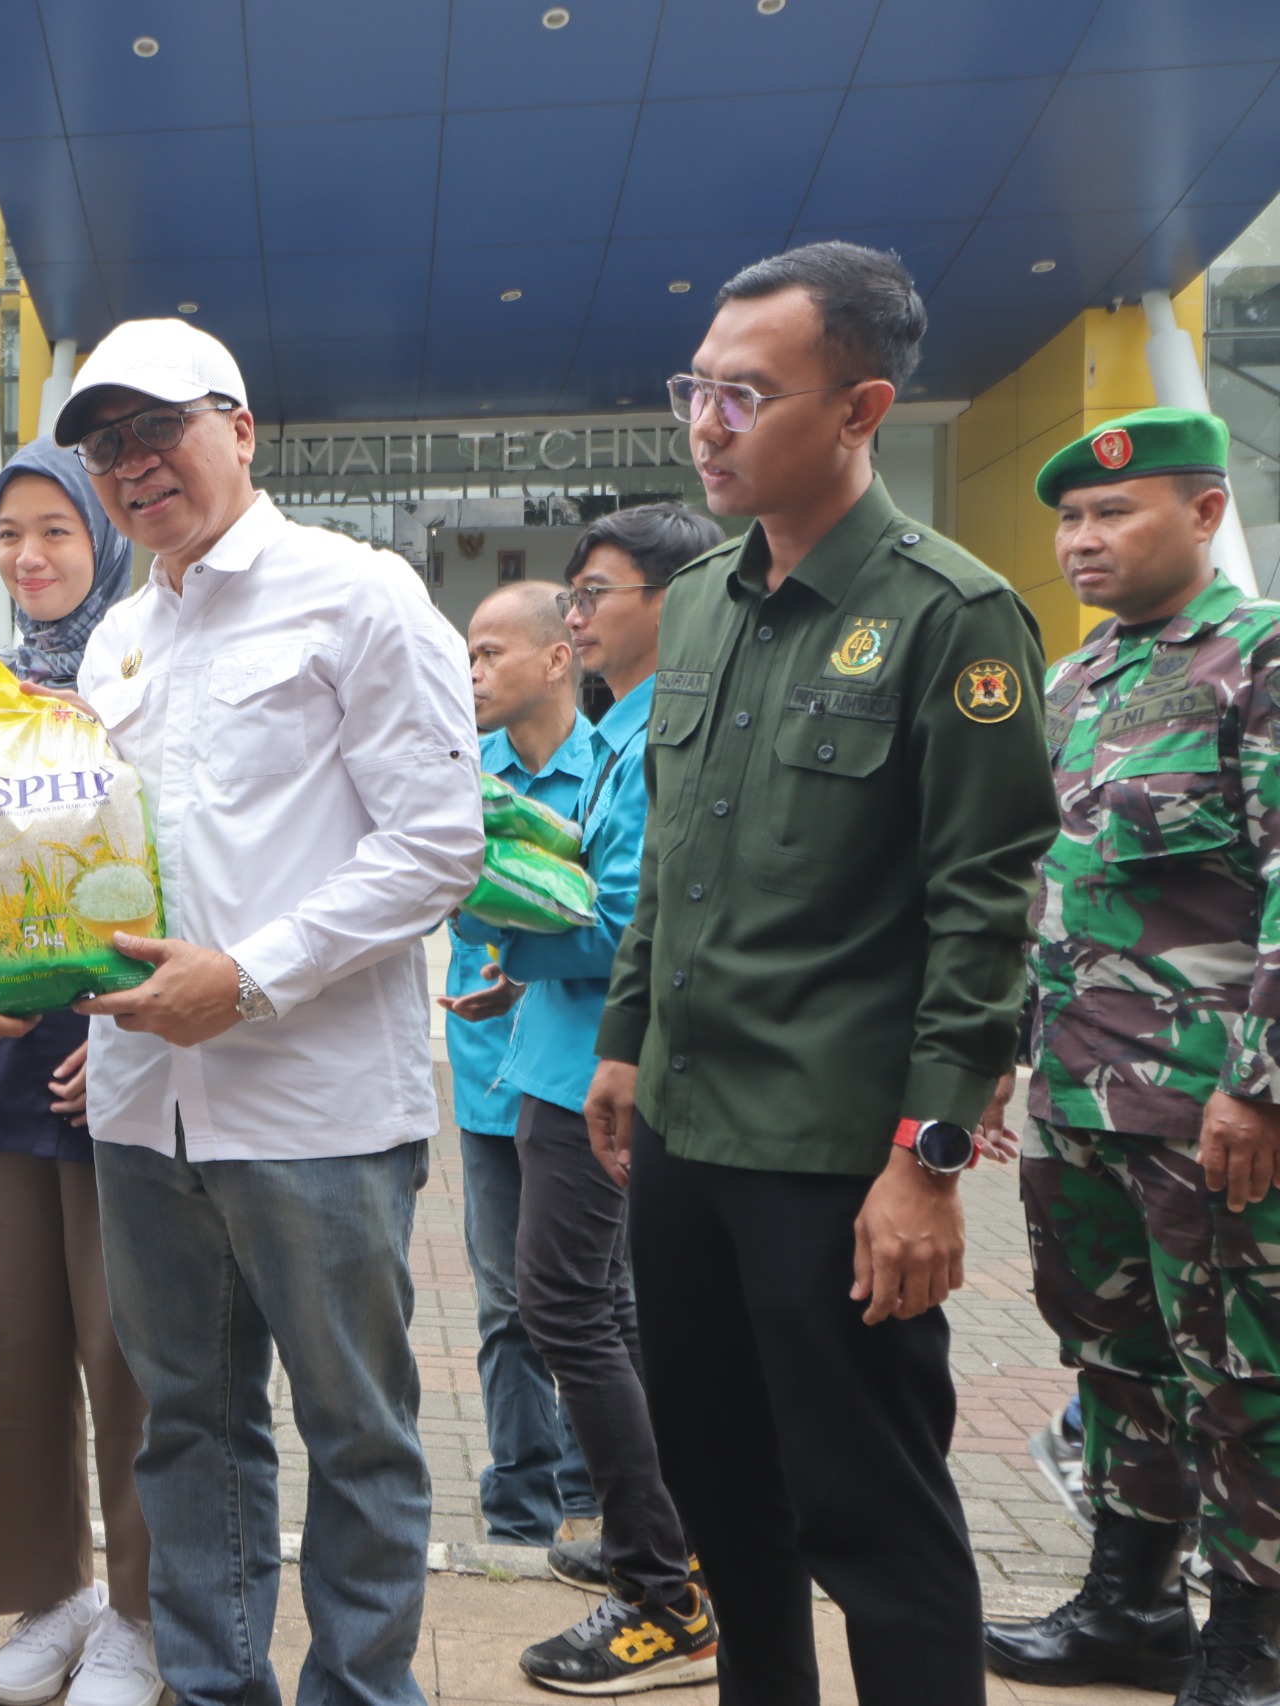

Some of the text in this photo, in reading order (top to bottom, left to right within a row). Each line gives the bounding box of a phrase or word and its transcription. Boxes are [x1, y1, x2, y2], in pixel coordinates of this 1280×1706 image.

[250, 431, 432, 478] CIMAHI
[1111, 693, 1198, 731] TNI AD
[23, 925, 40, 949] 5
